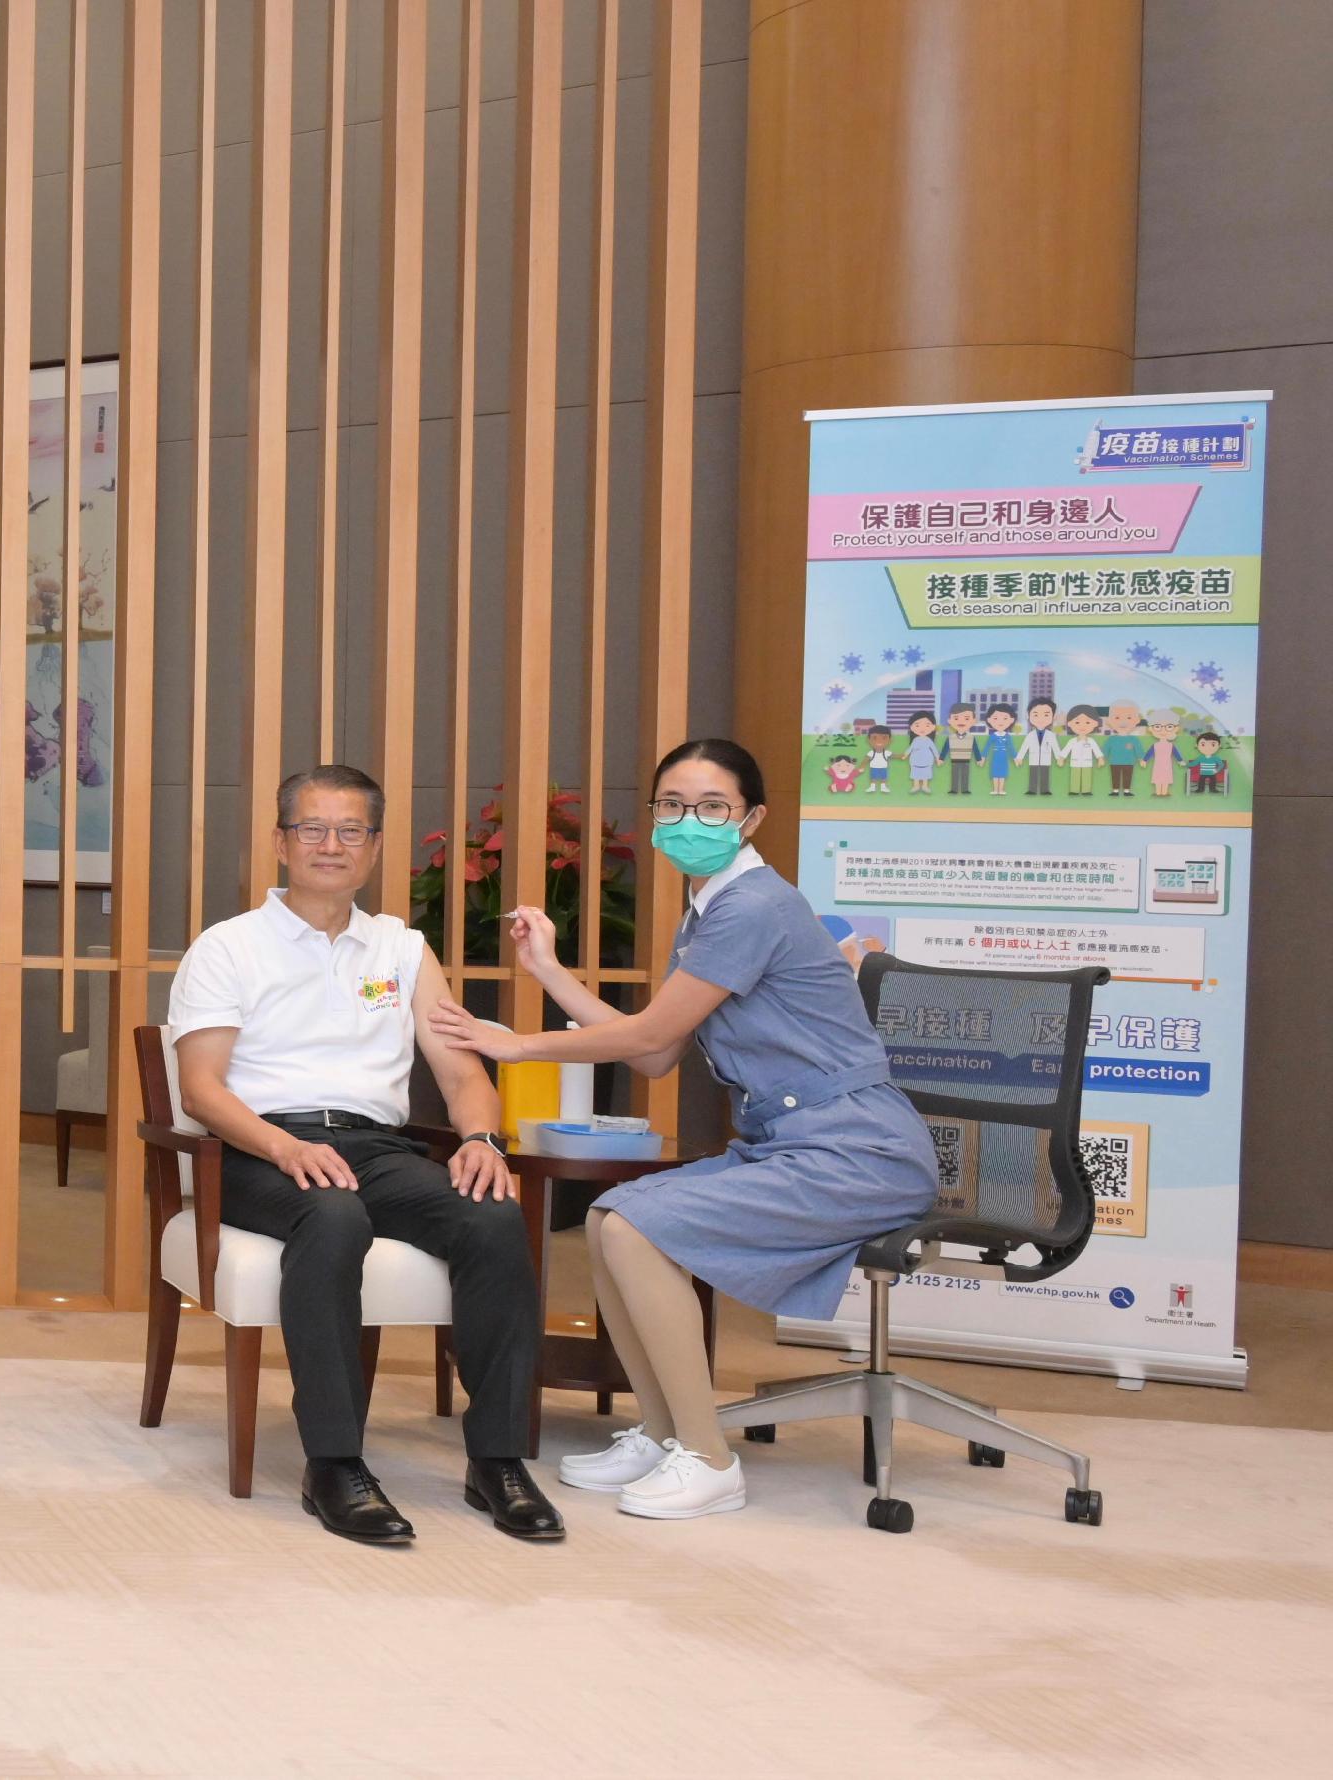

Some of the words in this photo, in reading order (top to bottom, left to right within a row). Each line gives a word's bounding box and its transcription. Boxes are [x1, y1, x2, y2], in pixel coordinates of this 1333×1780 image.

[1101, 431, 1240, 456] 疫苗接種計劃
[1124, 455, 1186, 464] Vaccination
[1190, 453, 1239, 461] Schemes
[861, 498, 1125, 530] 保護自己和身邊人
[833, 532, 892, 547] Protect
[897, 530, 965, 546] yourself
[969, 530, 1001, 543] and
[1004, 529, 1052, 542] those
[1057, 527, 1119, 541] around
[1124, 526, 1156, 542] you
[927, 568, 1231, 600] 接種季節性流感疫苗
[929, 602, 958, 616] Get
[963, 601, 1038, 615] seasonal
[1045, 600, 1121, 613] influenza
[1127, 598, 1230, 612] vaccination
[968, 937, 976, 947] 6
[981, 937, 1071, 951] 個月或以上人士
[876, 1004, 992, 1041] 早接種
[1032, 1058, 1062, 1074] Ear
[1090, 1063, 1200, 1082] protection
[905, 1274, 941, 1287] 2125
[945, 1277, 981, 1291] 2125
[1005, 1285, 1100, 1300] www.chp.gov.hk
[1145, 1315, 1184, 1326] Department
